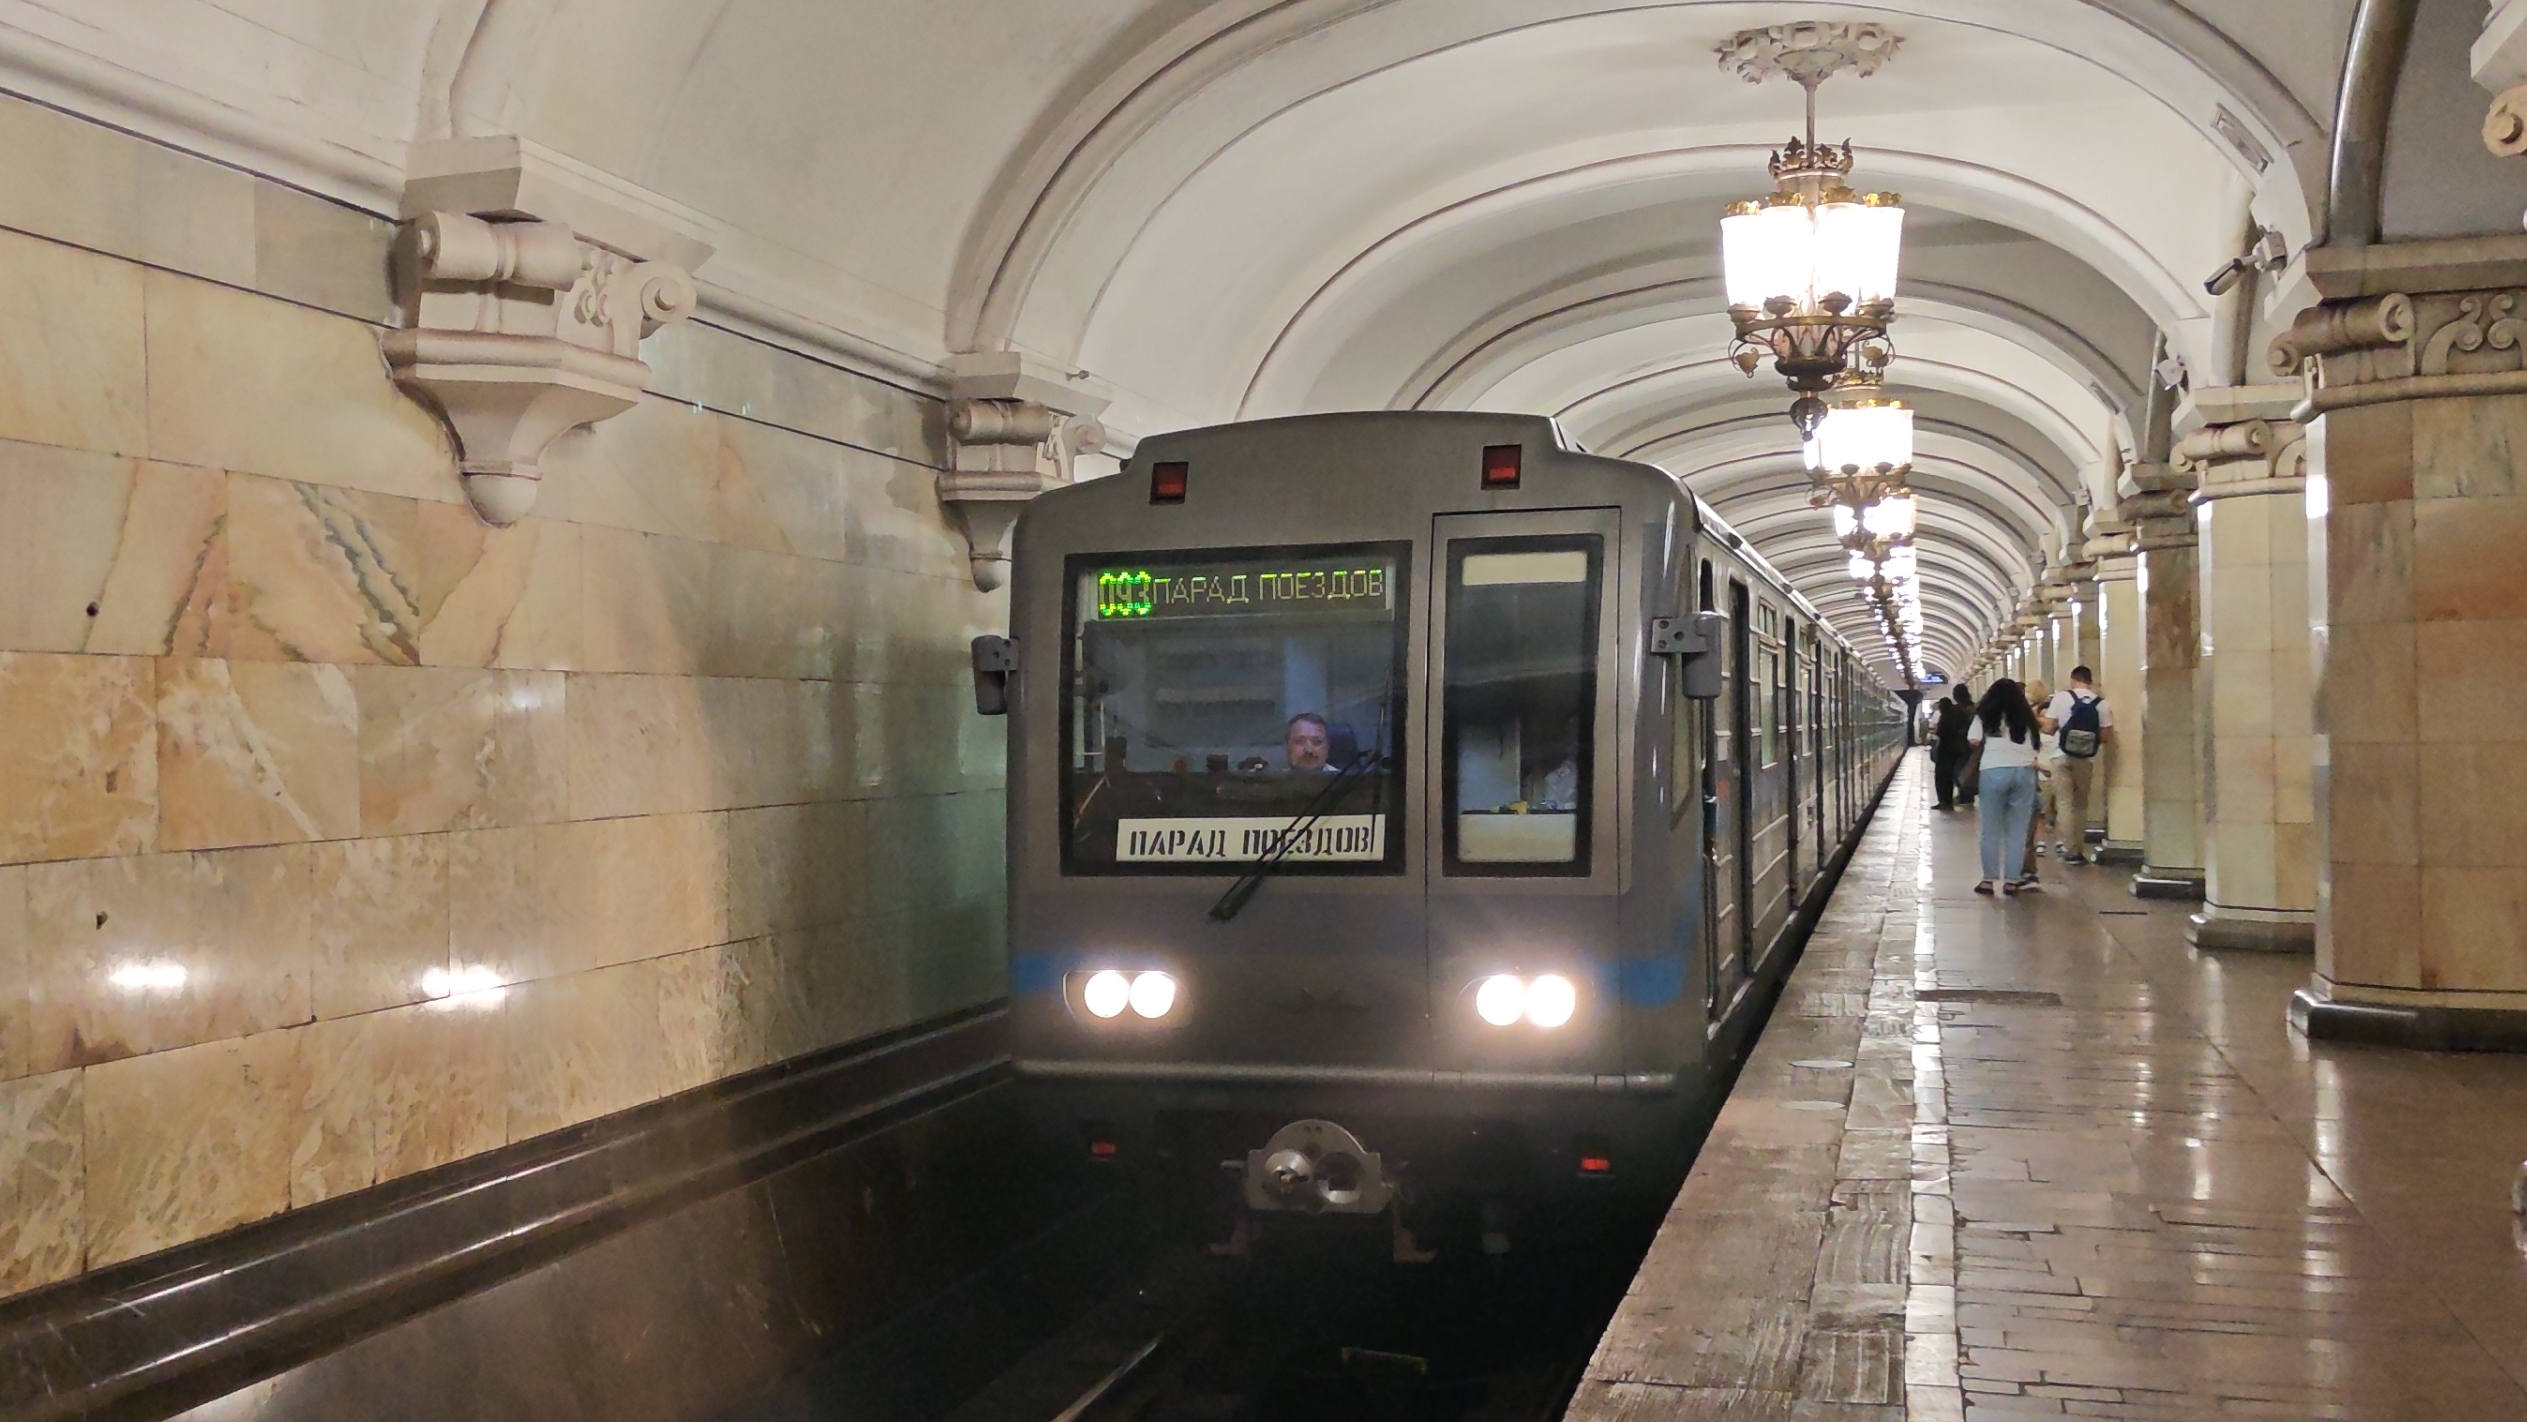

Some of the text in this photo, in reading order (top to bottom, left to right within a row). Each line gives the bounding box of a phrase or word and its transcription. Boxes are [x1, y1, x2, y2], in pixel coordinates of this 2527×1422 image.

[1099, 568, 1383, 616] 093 ПАРАД ПОЕЗДОВ
[1129, 826, 1370, 857] ПАРАД ПОЕЗДОВ
